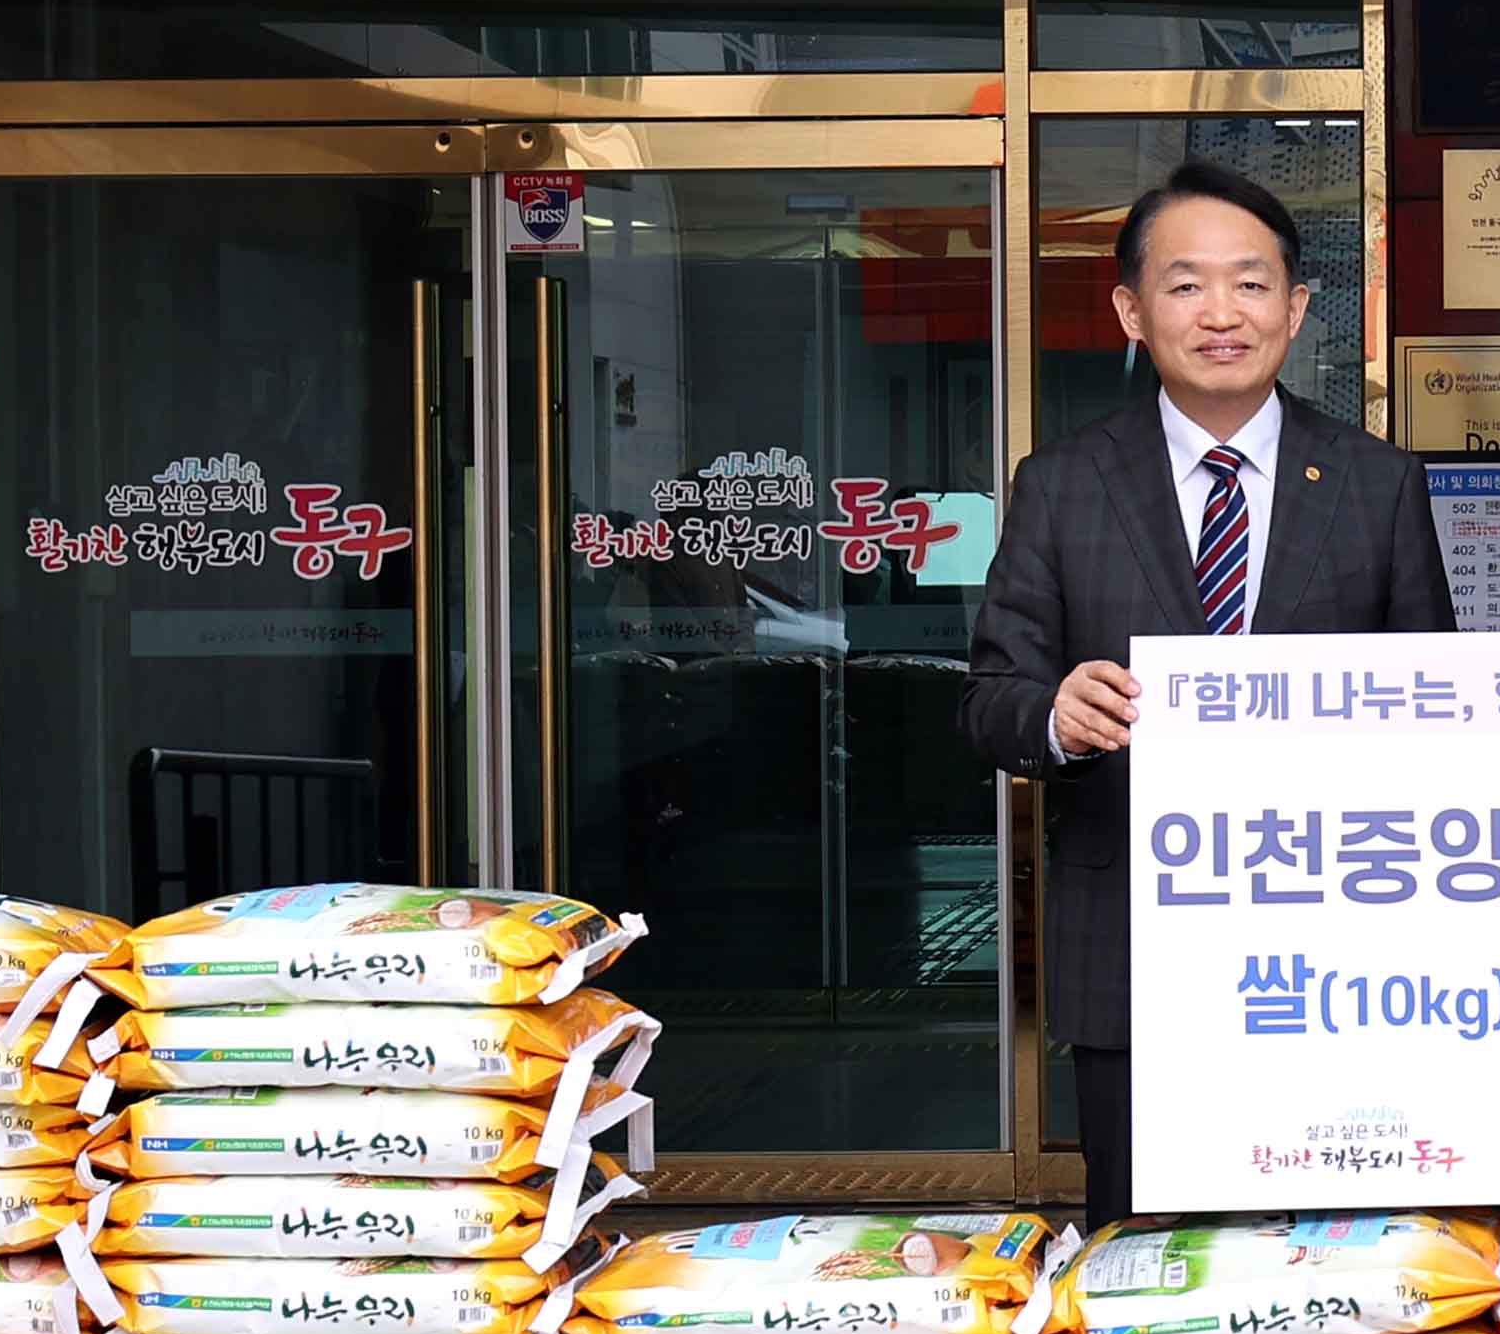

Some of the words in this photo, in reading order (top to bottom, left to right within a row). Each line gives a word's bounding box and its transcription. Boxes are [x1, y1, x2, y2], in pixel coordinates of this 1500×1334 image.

[513, 176, 543, 187] CCTV
[524, 208, 566, 224] BOSS
[1456, 372, 1480, 382] World
[1466, 419, 1490, 430] This
[158, 485, 207, 516] 싶은
[209, 485, 267, 514] 도시!
[703, 479, 755, 511] 싶은
[756, 479, 814, 510] 도시!
[1452, 502, 1477, 514] 502
[25, 517, 129, 572] 활기찬
[133, 520, 265, 574] 행복도시
[271, 483, 413, 581] 동구
[571, 512, 675, 568] 활기찬
[678, 515, 813, 569] 행복도시
[818, 478, 962, 574] 동구
[1452, 544, 1476, 556] 402
[1452, 565, 1476, 576] 404
[1452, 584, 1476, 597] 407
[1453, 604, 1476, 617] 411
[1167, 670, 1290, 722] 『함께
[1311, 669, 1475, 724] 나누는,
[463, 1127, 481, 1139] 10
[485, 1127, 504, 1141] kg
[146, 1140, 169, 1150] NH
[1250, 1144, 1312, 1174] 활기찬
[1320, 1145, 1404, 1174] 행복도시
[1408, 1139, 1465, 1175] 동구
